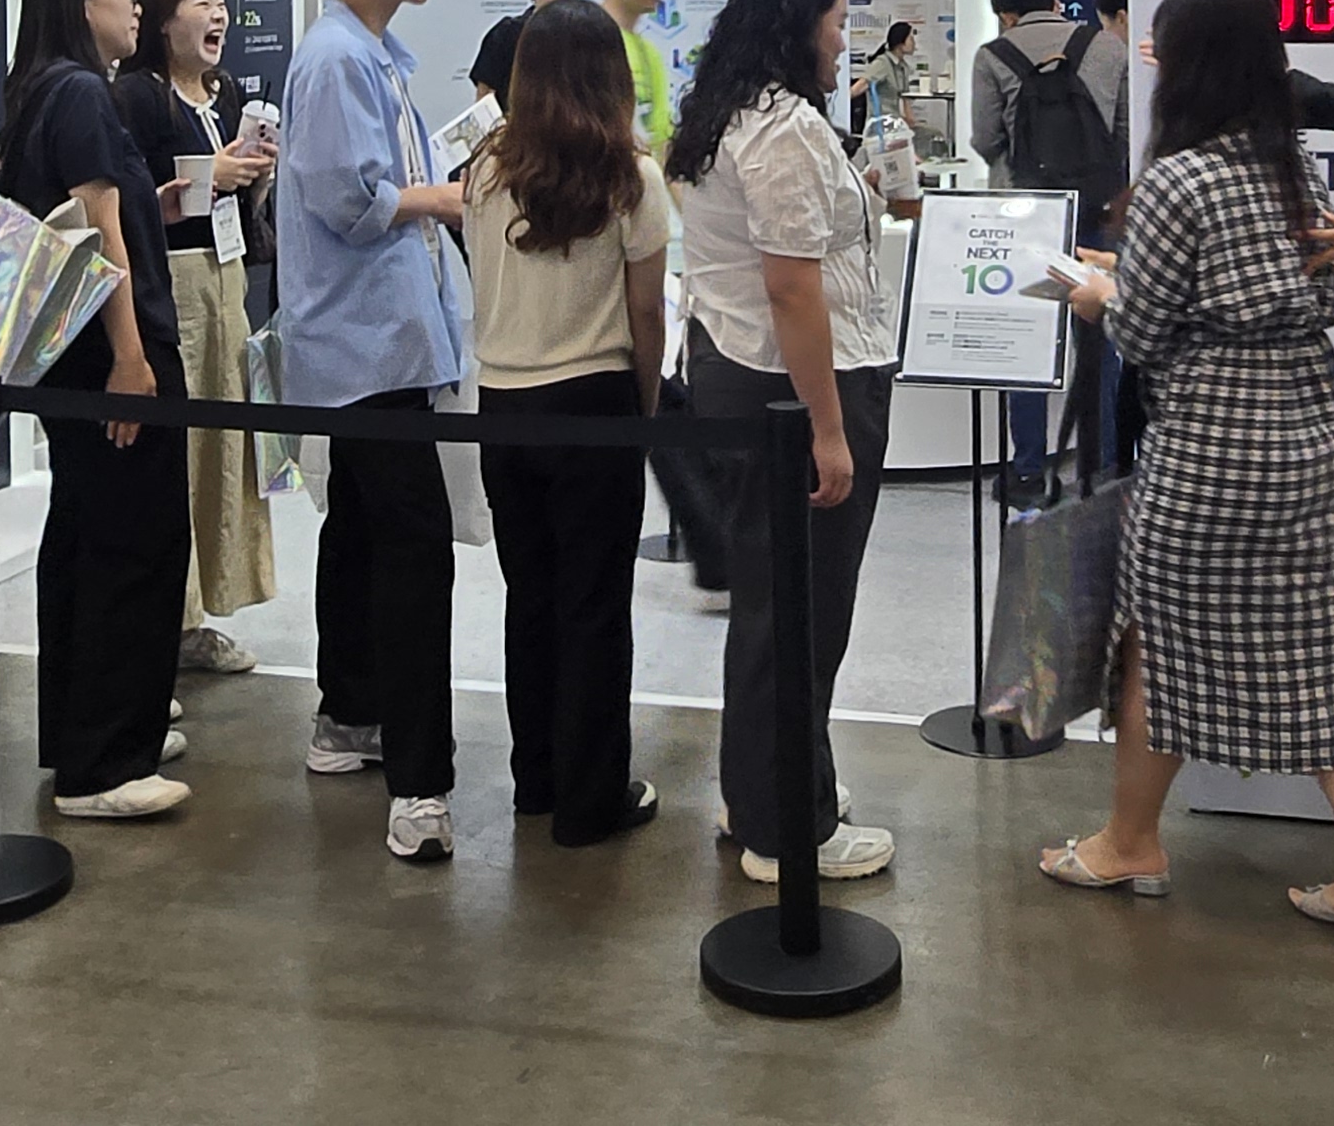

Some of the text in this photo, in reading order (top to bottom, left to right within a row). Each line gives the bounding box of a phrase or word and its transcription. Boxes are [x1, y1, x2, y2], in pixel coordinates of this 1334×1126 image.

[969, 228, 1015, 240] CATCH
[967, 247, 1012, 261] NEXT
[961, 264, 1014, 295] 10
